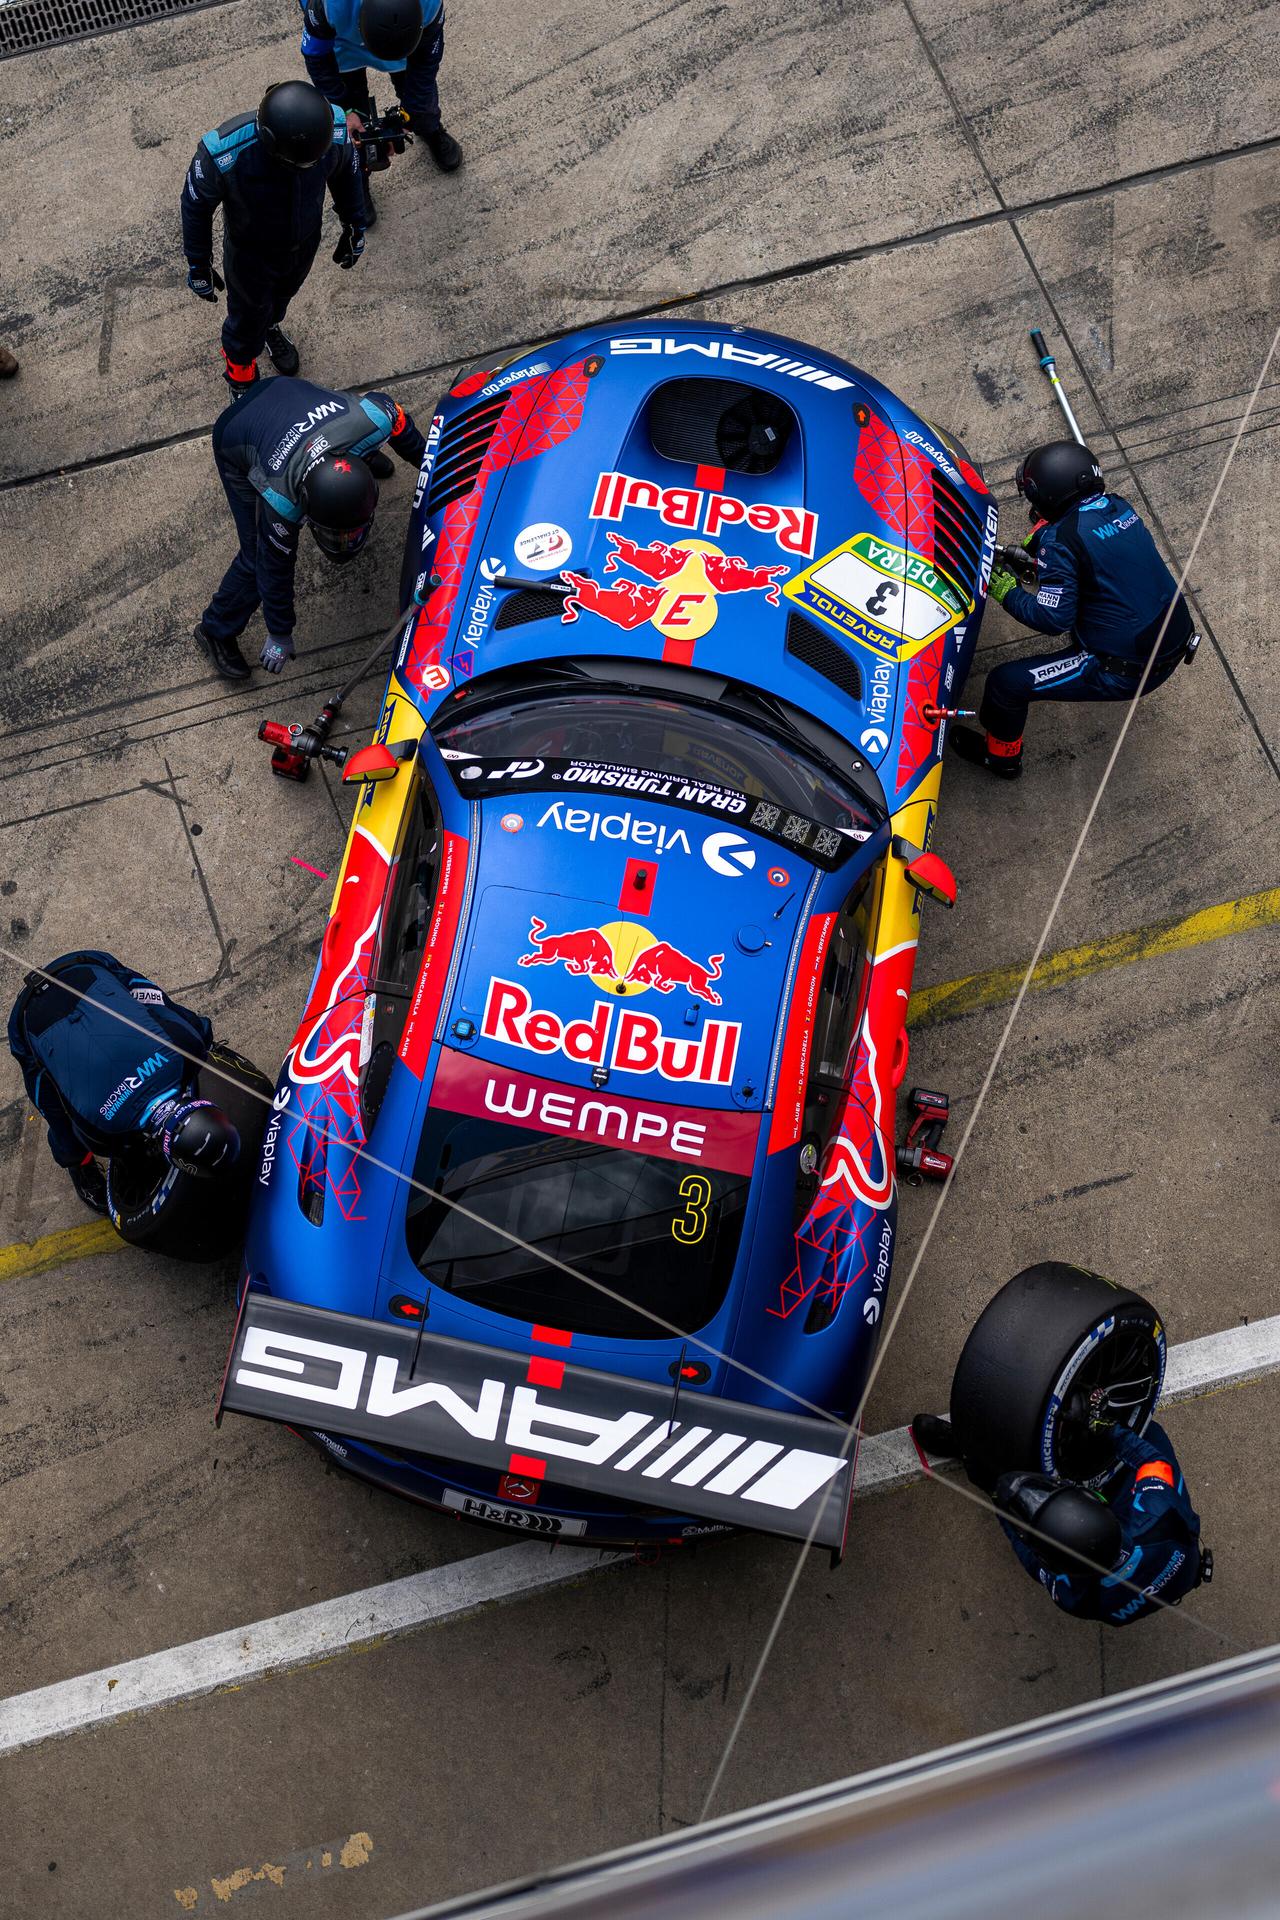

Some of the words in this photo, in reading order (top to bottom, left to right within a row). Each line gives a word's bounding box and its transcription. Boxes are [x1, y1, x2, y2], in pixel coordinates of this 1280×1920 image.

[218, 154, 233, 166] OMP
[500, 365, 540, 388] Player
[267, 428, 295, 467] RACING
[272, 430, 302, 471] WINWARD
[309, 439, 330, 458] OMP
[412, 415, 444, 509] FALKEN
[920, 439, 953, 475] Player
[589, 471, 705, 531] Bull
[703, 492, 819, 560] Red
[867, 540, 939, 589] DEKRA
[978, 505, 998, 600] FALKEN
[463, 583, 497, 648] viaplay
[866, 581, 899, 616] 3
[809, 589, 896, 650] RAVENOL
[426, 667, 447, 688] E
[866, 657, 895, 725] viaplay
[563, 767, 673, 796] TURISMO
[570, 760, 639, 774] SIMULATOR
[641, 769, 689, 785] DRIVING
[676, 788, 747, 814] GRAN
[691, 780, 721, 793] REAL
[722, 790, 747, 800] THE
[536, 801, 692, 855] viaplay
[441, 854, 453, 895] VERSTAPPEN
[430, 917, 442, 947] GOUNON
[818, 917, 831, 955] VERSTAPPEN
[412, 971, 428, 1016] JUNCADELLA
[808, 976, 816, 1008] GOUNON
[401, 1037, 411, 1057] AUER
[480, 976, 614, 1066] Red
[610, 1008, 742, 1087] Bull
[800, 1030, 809, 1077] JUNCADELLA
[99, 1079, 128, 1116] RACING
[104, 1087, 134, 1121] WINWARD
[484, 1079, 707, 1157] WEMPE
[259, 1113, 282, 1186] viaplay
[672, 1175, 712, 1244] 3
[873, 1219, 894, 1293] viaplay
[236, 1326, 655, 1466] AMG
[1154, 1550, 1182, 1585] WINWARD
[1158, 1553, 1186, 1588] RACING
